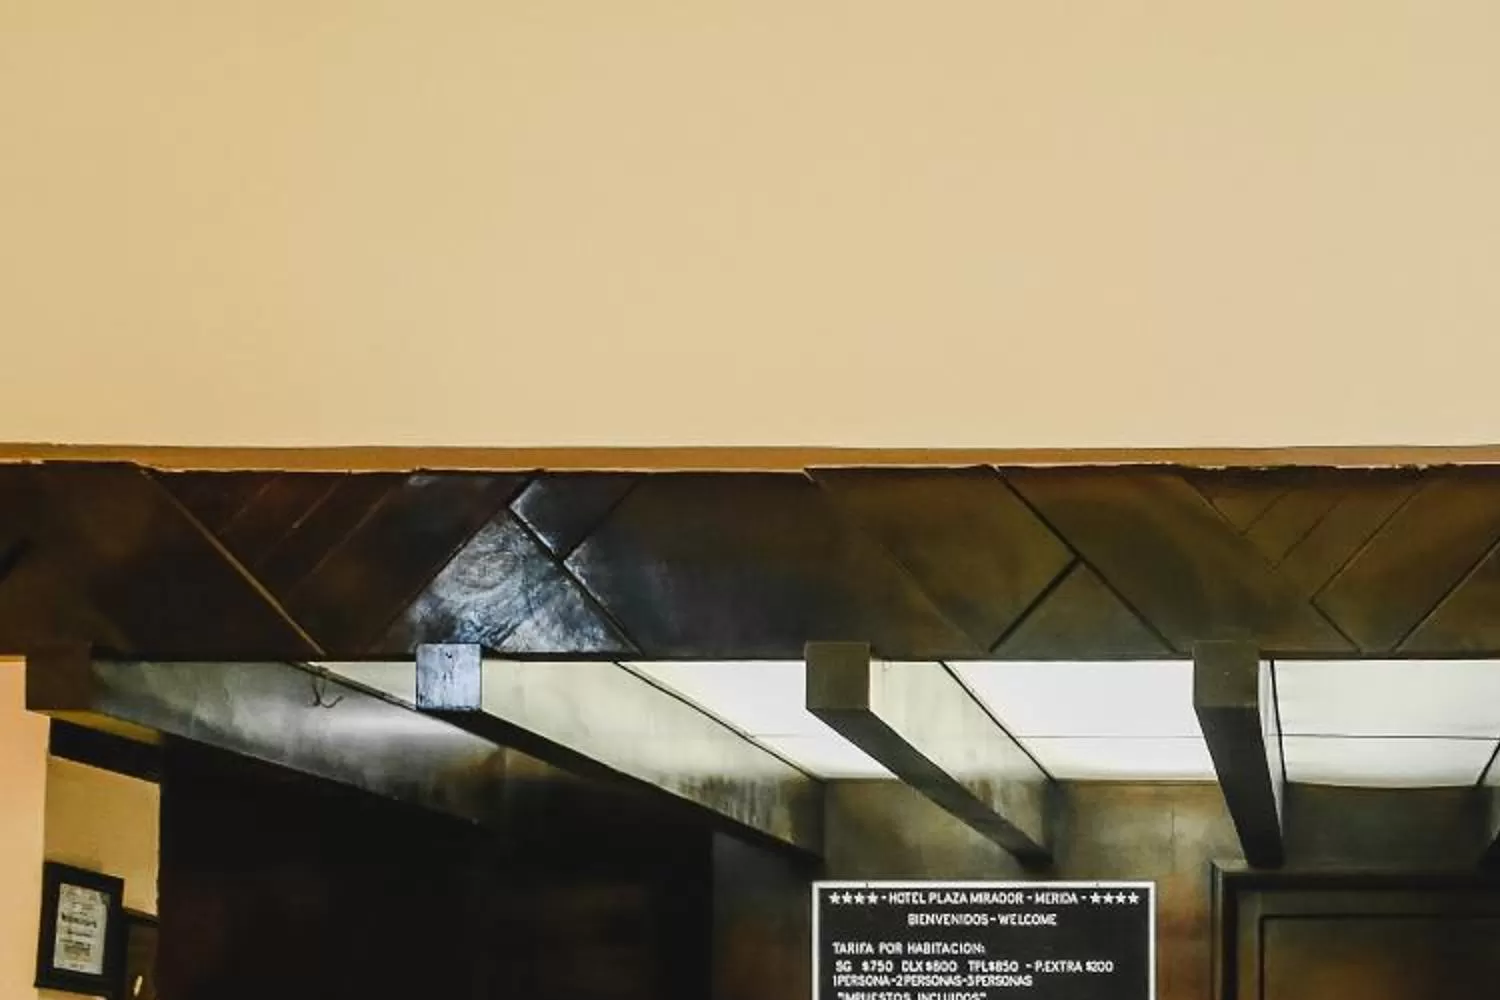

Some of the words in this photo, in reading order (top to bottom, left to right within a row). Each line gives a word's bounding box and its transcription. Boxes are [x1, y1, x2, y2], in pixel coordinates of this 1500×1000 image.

[888, 891, 927, 905] HOTEL
[927, 891, 968, 905] PLAZA
[969, 891, 1024, 905] MIRADOR
[1034, 891, 1079, 905] MERIDA
[832, 941, 875, 955] TARIFA
[878, 941, 903, 955] POR
[835, 959, 853, 973] SG
[861, 959, 894, 973] $750
[1085, 959, 1114, 973] $200
